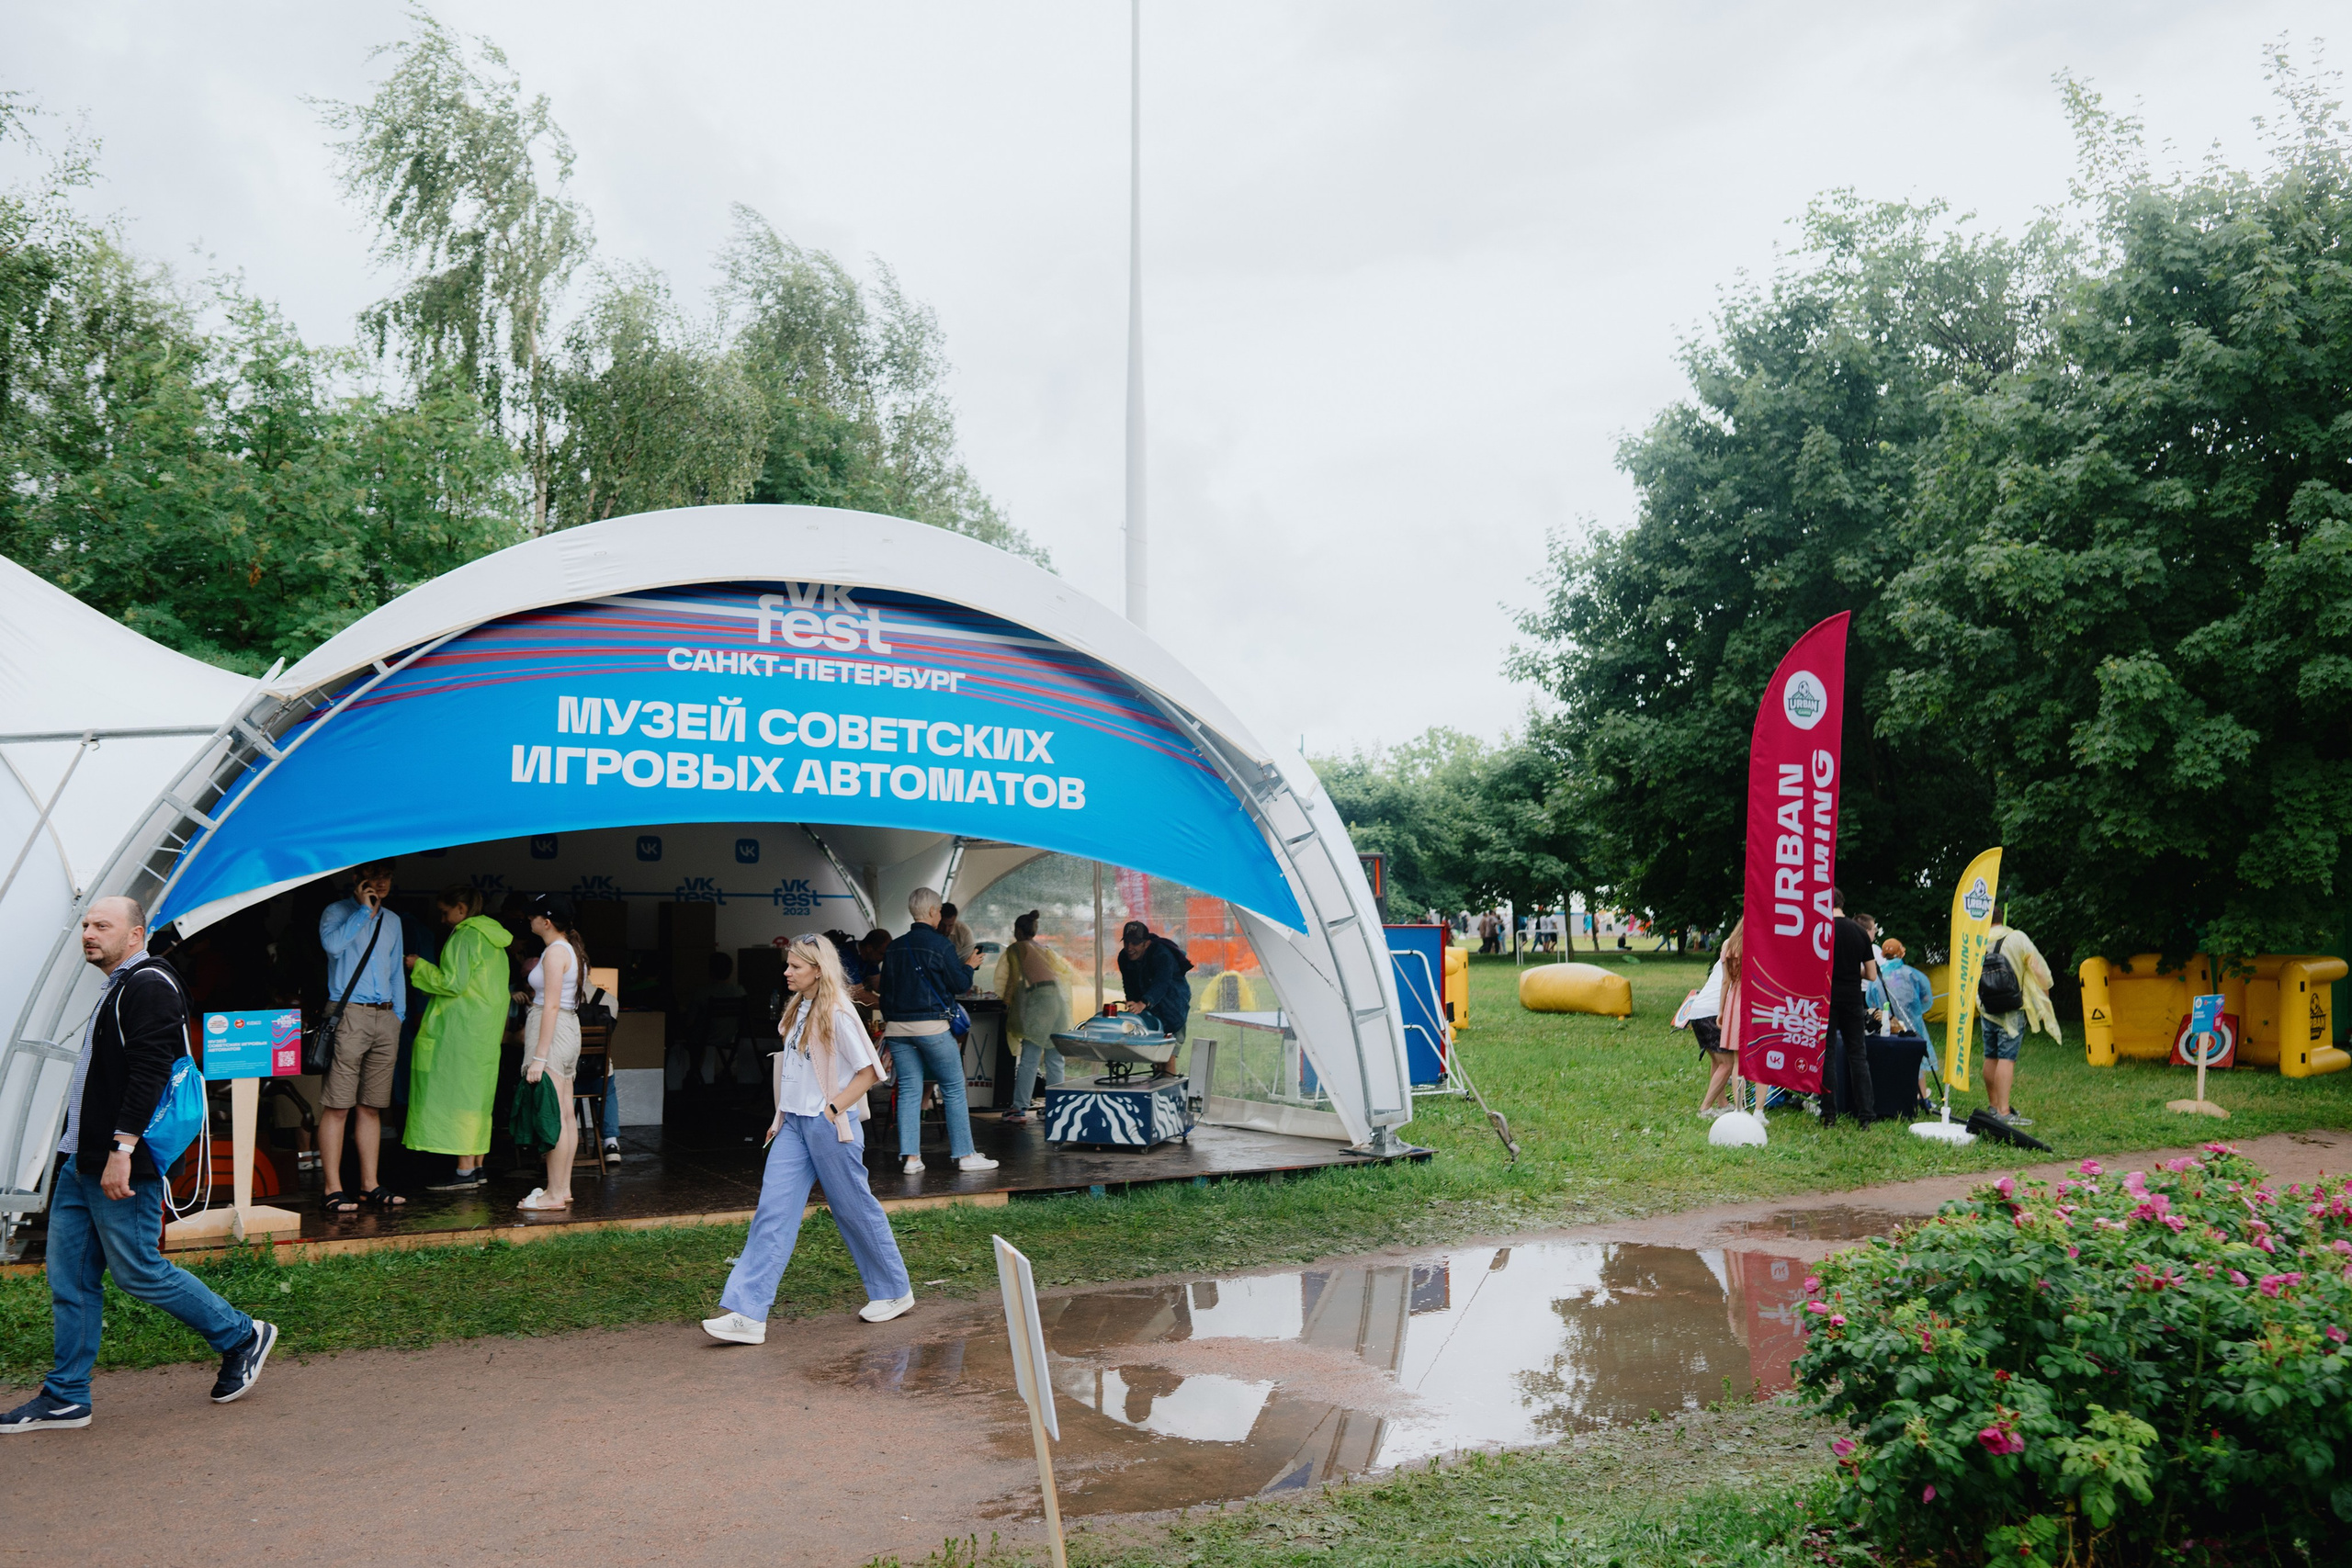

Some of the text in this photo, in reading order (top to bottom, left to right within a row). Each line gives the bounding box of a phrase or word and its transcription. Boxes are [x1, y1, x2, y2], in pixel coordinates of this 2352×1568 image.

[785, 581, 864, 614] VK
[758, 593, 891, 654] fest
[667, 648, 966, 693] САНКТ-ПЕТЕРБУРГ
[558, 695, 1055, 764] МУЗЕЙ СОВЕТСКИХ
[512, 745, 1086, 810] ИГРОВЫХ АВТОМАТОВ
[1774, 763, 1804, 937] URBAN
[1812, 750, 1835, 961] GAMING
[581, 875, 613, 889] VK
[684, 877, 715, 891] VK
[773, 887, 821, 907] fest
[781, 879, 810, 892] VK
[783, 908, 810, 916] 2023
[1771, 1006, 1822, 1036] fes
[1785, 996, 1819, 1019] VK
[1781, 1032, 1816, 1049] 2023
